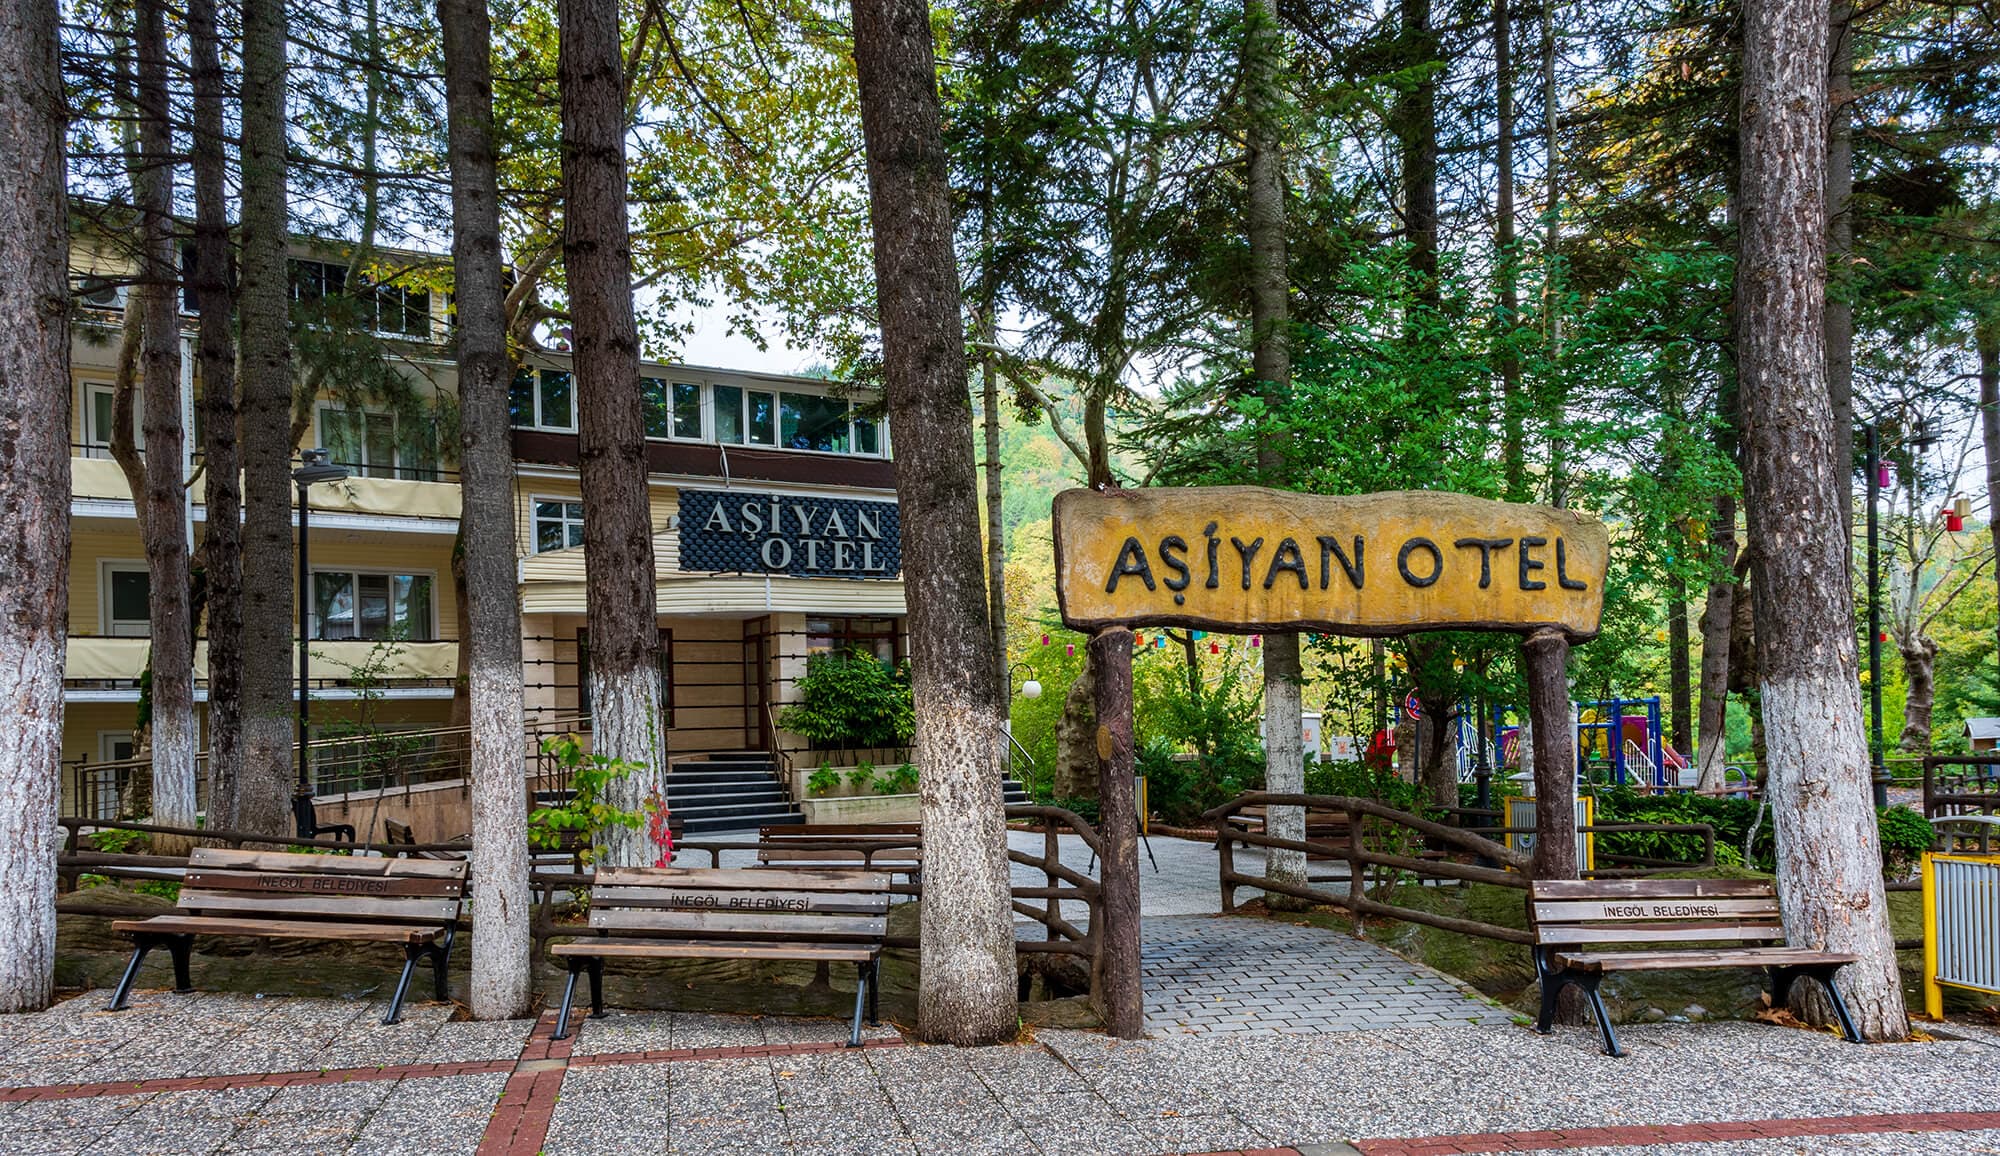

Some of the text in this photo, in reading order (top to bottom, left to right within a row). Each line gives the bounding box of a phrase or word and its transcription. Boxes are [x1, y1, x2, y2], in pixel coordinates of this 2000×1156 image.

[703, 495, 882, 540] AŞİYAN
[761, 538, 886, 572] OTEL
[1105, 520, 1588, 605] AŞİYAN OTEL
[671, 893, 809, 911] İNEGÖL BELEDİYESİ
[1653, 904, 1719, 917] BELEDİYESİ
